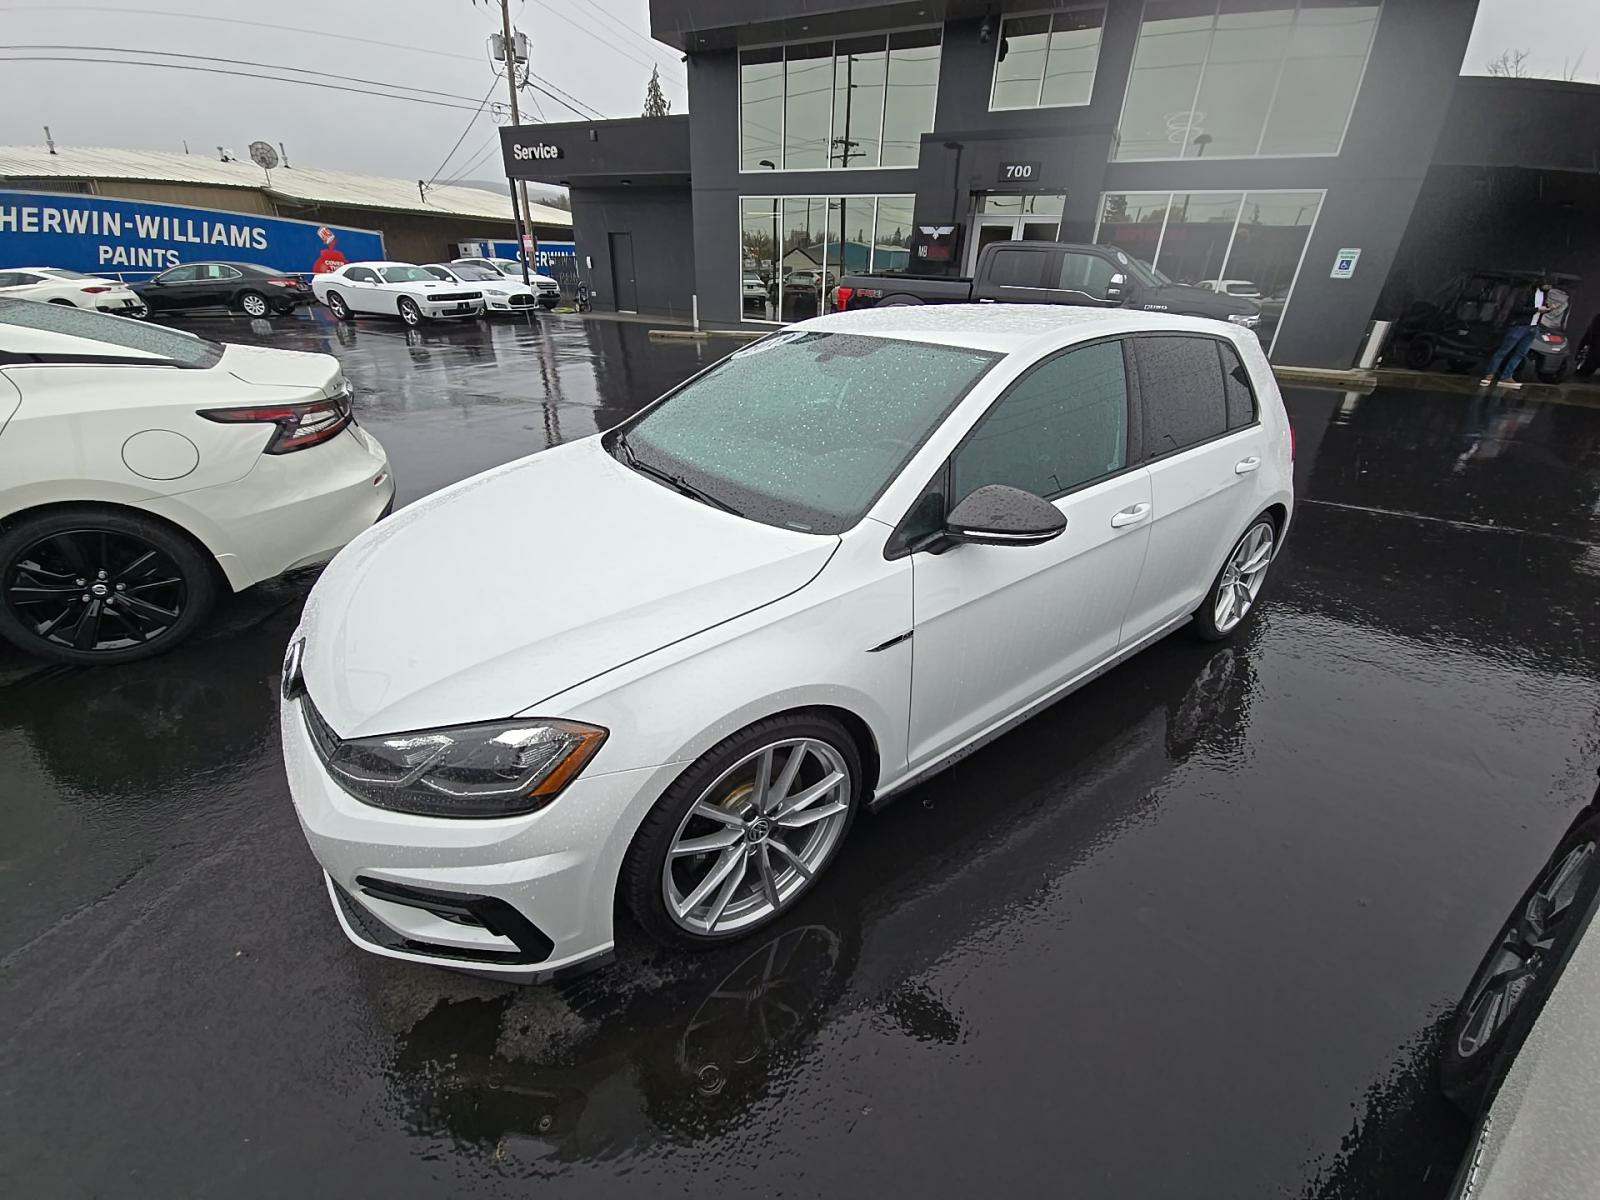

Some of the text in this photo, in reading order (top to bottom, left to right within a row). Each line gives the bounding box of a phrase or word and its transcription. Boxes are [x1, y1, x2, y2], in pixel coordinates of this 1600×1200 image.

[513, 142, 558, 160] Service
[1006, 165, 1032, 178] 700
[99, 245, 181, 268] PAINTS
